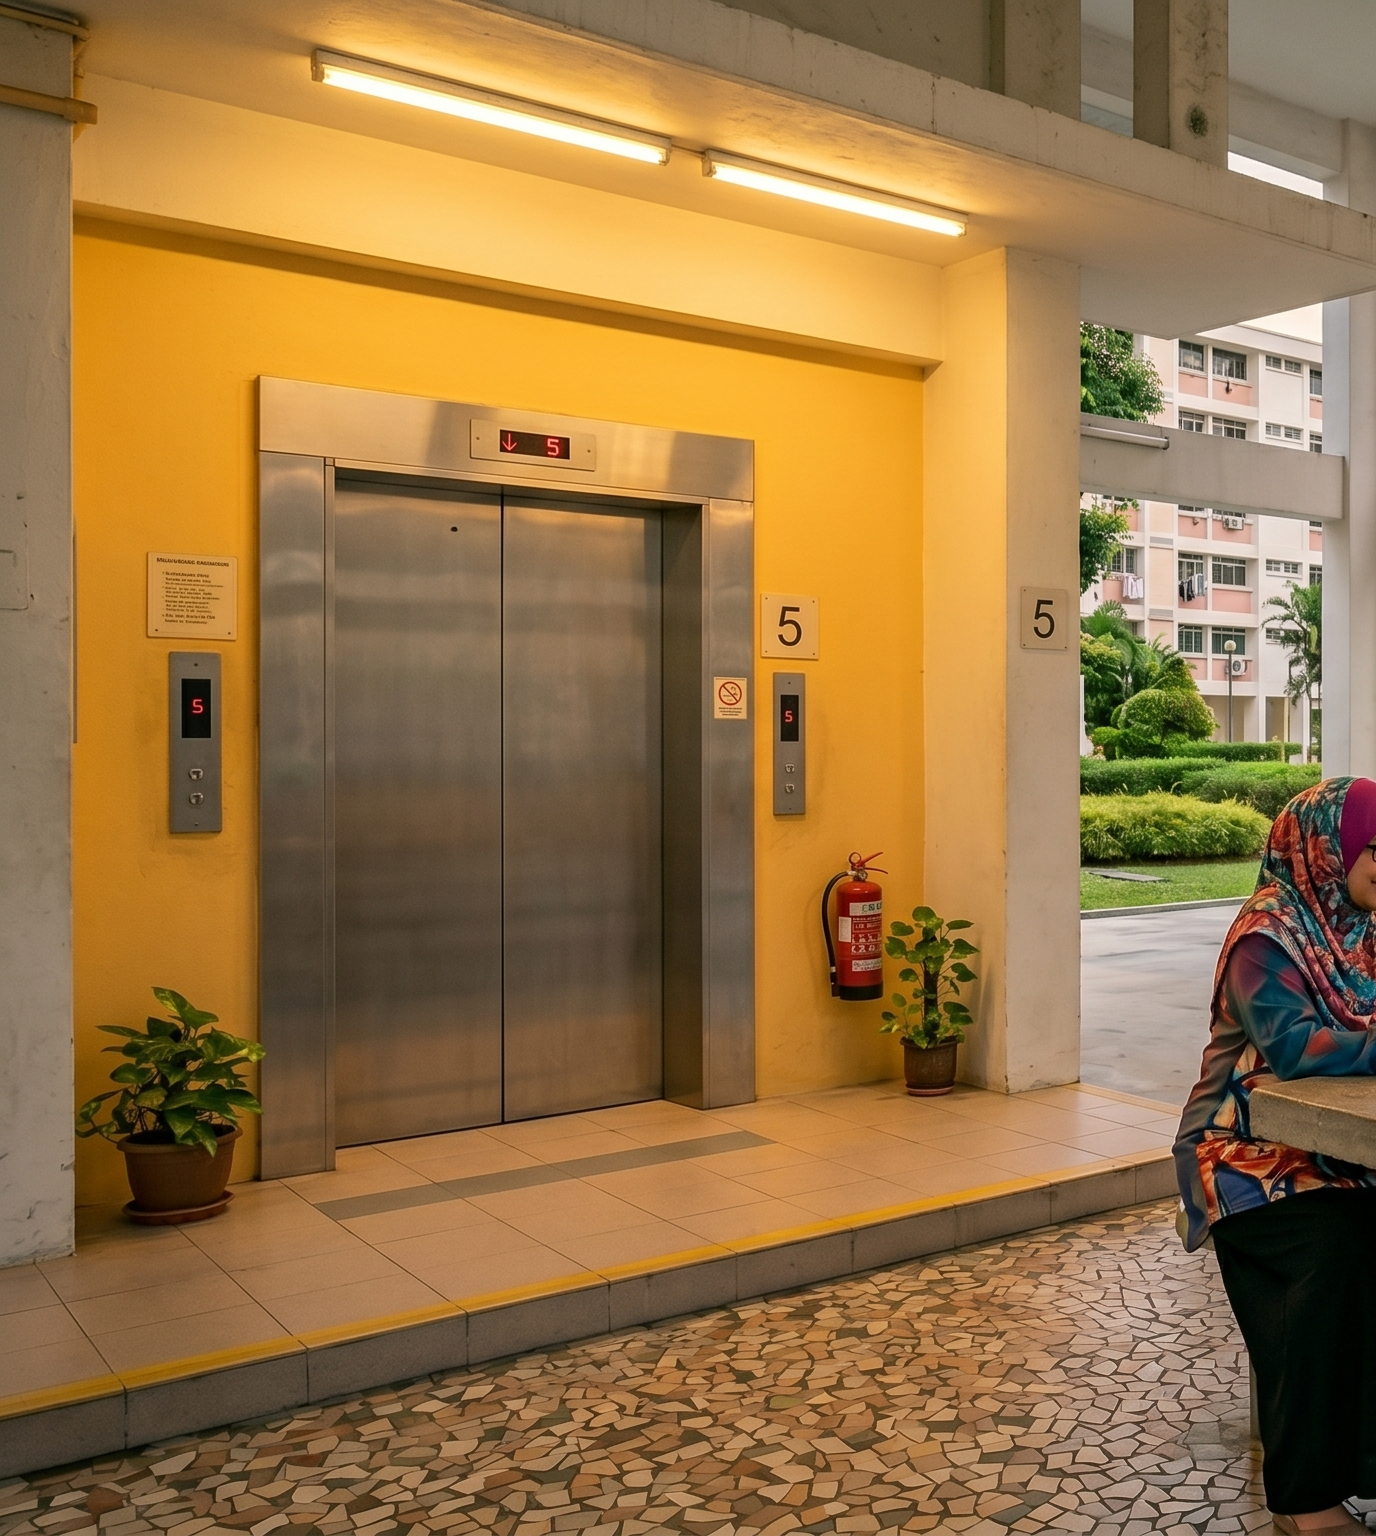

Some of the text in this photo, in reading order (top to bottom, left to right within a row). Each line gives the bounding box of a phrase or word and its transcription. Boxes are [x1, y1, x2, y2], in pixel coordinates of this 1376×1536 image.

[547, 438, 559, 456] 5
[777, 605, 802, 647] 5
[1033, 599, 1056, 639] 5
[192, 699, 204, 714] 5
[785, 710, 793, 723] 5
